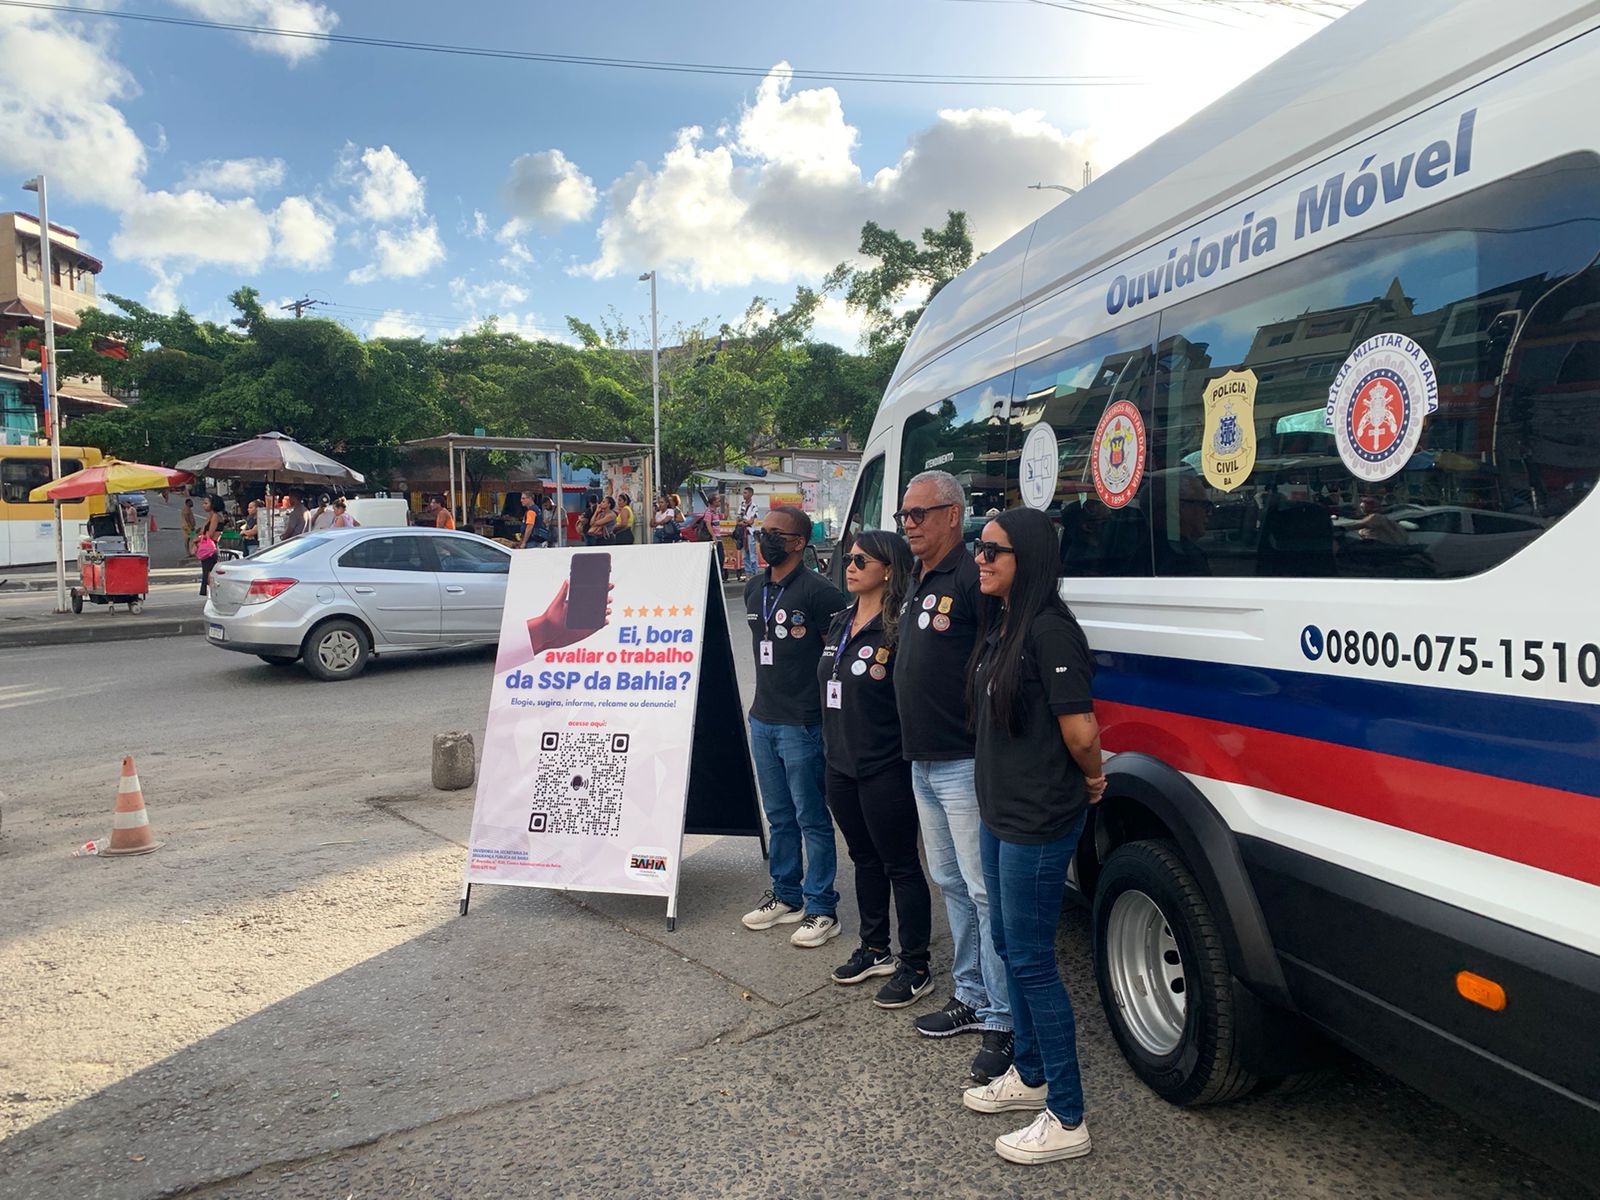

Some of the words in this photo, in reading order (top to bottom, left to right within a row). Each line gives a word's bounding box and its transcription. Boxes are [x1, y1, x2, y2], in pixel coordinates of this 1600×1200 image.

[1106, 211, 1278, 315] Ouvidoria
[1294, 108, 1478, 240] Móvel
[1325, 363, 1352, 426] POLÍCIA
[1353, 335, 1403, 362] MILITAR
[1404, 340, 1421, 360] DA
[1419, 359, 1437, 413] BAHIA
[1132, 455, 1143, 488] BAHIA
[1216, 460, 1239, 473] CIVIL
[1224, 477, 1232, 485] BA
[619, 626, 641, 646] Ei,
[646, 626, 694, 643] bora
[545, 648, 604, 663] avaliar
[606, 651, 617, 663] o
[620, 648, 694, 663] trabalho
[1327, 629, 1600, 688] 0800-075-1510
[505, 670, 533, 690] da
[538, 671, 581, 690] SSP
[584, 671, 611, 690] da
[616, 671, 691, 690] Bahia?
[511, 698, 536, 707] Elogie,
[537, 699, 563, 708] sugira,
[565, 699, 597, 708] informe,
[640, 699, 677, 708] denuncie!
[590, 720, 607, 728] aqui:
[630, 857, 666, 871] BAHIA
